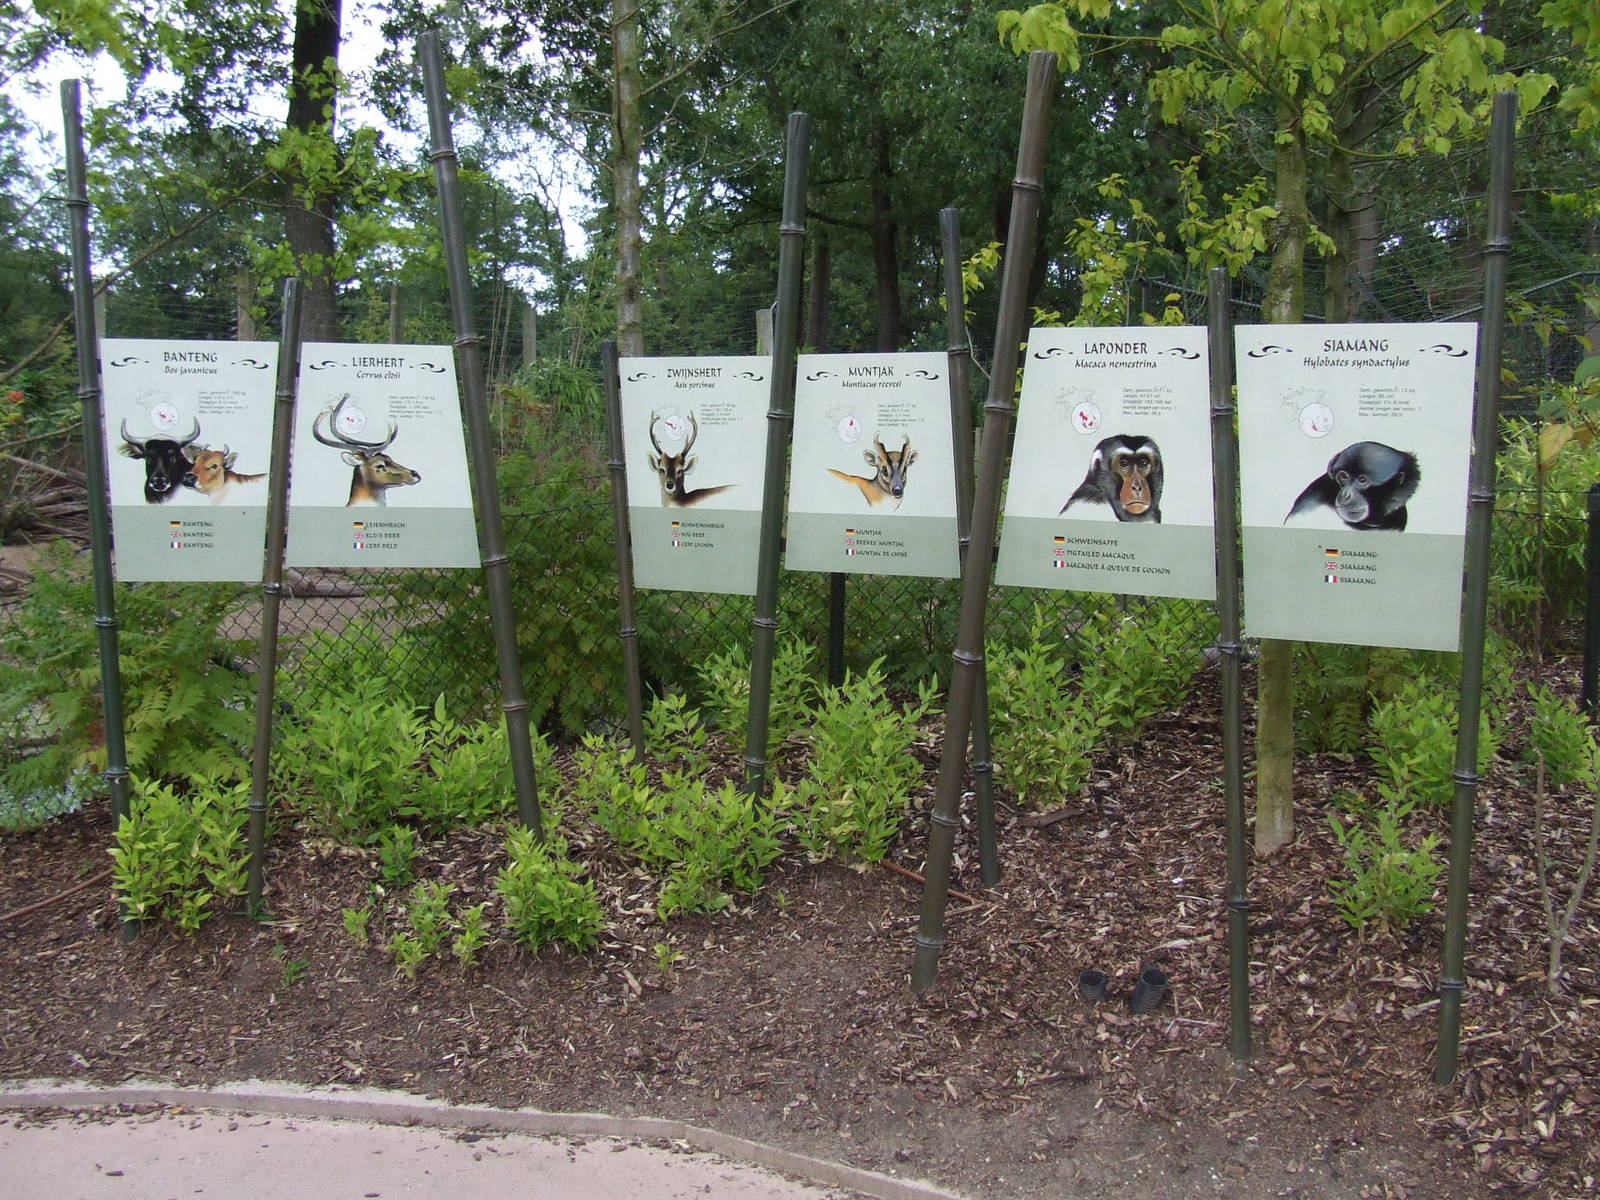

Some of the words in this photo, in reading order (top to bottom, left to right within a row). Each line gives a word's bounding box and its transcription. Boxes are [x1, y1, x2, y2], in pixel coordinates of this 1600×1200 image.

[1084, 342, 1148, 355] LAPONDER
[1323, 339, 1389, 353] SIAMANG
[163, 352, 218, 362] BANTENG
[352, 357, 405, 368] LIERHERT
[1075, 359, 1107, 369] Macaca
[1108, 359, 1157, 369] nemestrina
[1303, 356, 1349, 369] Hylobates
[1351, 356, 1410, 369] syndactylus
[164, 365, 178, 375] Bos
[179, 365, 218, 376] javanicus
[356, 370, 382, 379] Cervus
[384, 370, 401, 379] eldii
[667, 367, 722, 379] ZWIJNSHERT
[848, 366, 894, 378] MUNTJAK
[841, 380, 877, 388] Muntiacus
[1066, 537, 1118, 546] SCHWEINSAFFE
[1066, 550, 1100, 558] PIGTAILED
[1102, 551, 1136, 560] MACAQUE
[1340, 550, 1378, 559] SIAMANG
[1066, 562, 1099, 571] MACAQUE
[1142, 566, 1171, 575] COCHON
[1340, 563, 1377, 571] SIAMANG
[1340, 576, 1377, 585] SIAMANG
